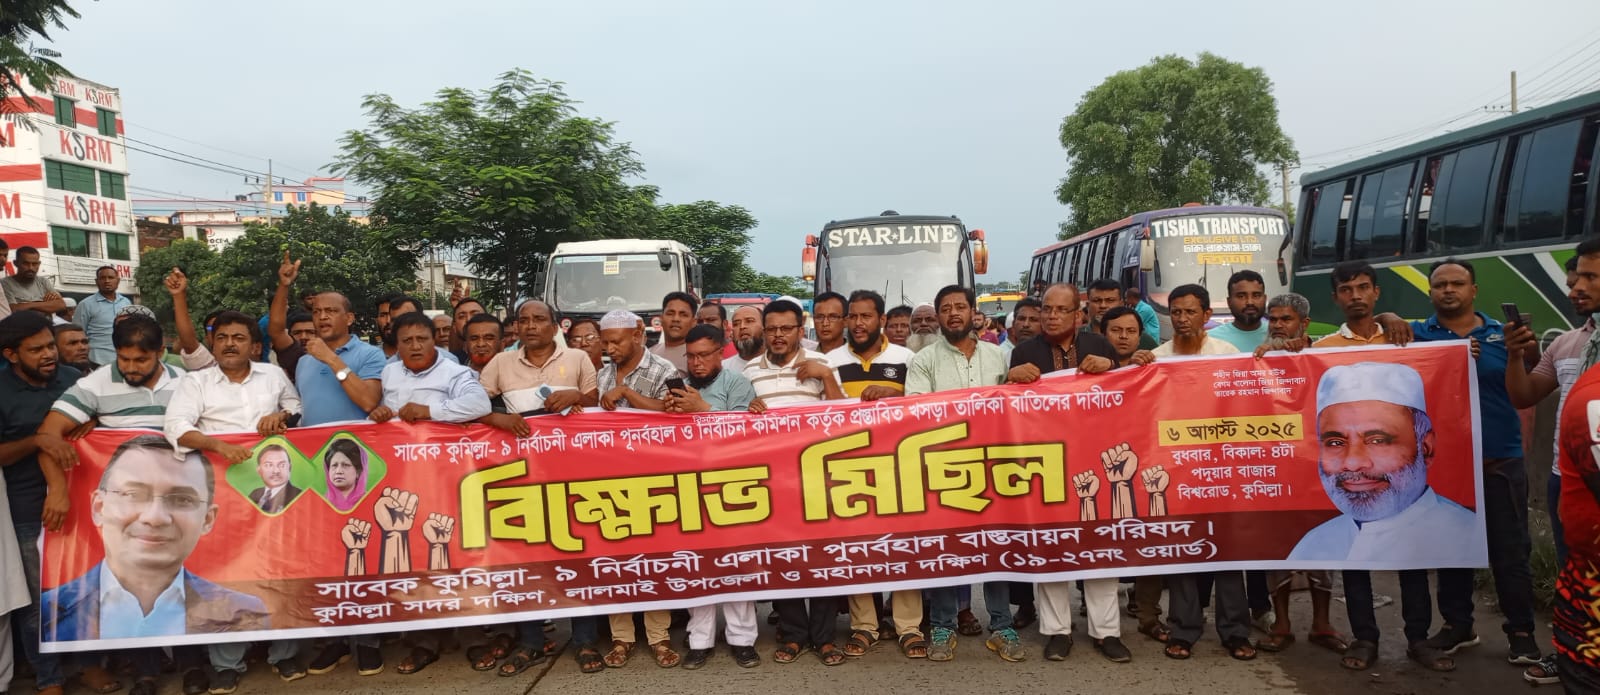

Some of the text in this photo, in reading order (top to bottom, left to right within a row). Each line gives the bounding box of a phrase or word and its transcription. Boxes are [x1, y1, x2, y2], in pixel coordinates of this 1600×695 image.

[85, 87, 113, 107] KSRM
[59, 129, 113, 164] KSRM
[63, 194, 117, 226] KSRM
[828, 224, 959, 248] STAR LINE
[1152, 217, 1285, 238] TISHA TRANSPORT
[1183, 235, 1238, 244] EXCLUSIVE
[1258, 377, 1274, 386] জিয়া
[1276, 376, 1306, 385] জিন্দাবাদ
[393, 442, 441, 462] সাবেক
[501, 440, 511, 456] ৯
[571, 430, 615, 450] এলাকা
[681, 425, 693, 440] ও
[805, 406, 845, 436] কর্তৃক
[850, 402, 904, 426] প্রস্তাবিত
[908, 401, 948, 422] খসড়া
[952, 392, 1004, 417] তালিকা
[1009, 389, 1072, 413] বাতিলের
[1074, 384, 1125, 410] দাবীতে
[1166, 419, 1297, 442] ৬ আগস্ট ২০২৫
[1221, 443, 1267, 461] বিকাল:
[1271, 442, 1295, 460] ৪টা
[1191, 464, 1276, 483] পদুয়ার বাজার
[459, 421, 1067, 553] বিক্ষোভ মিছিল
[1240, 480, 1283, 501] কুমিল্লা
[315, 577, 421, 600] সাবেক
[555, 565, 578, 582] ৯
[589, 550, 704, 580] নির্বাচনী
[714, 544, 813, 569] এলাকা
[823, 533, 947, 564] পুনর্বহাল
[956, 526, 1084, 549] বাস্তবায়ন
[1094, 518, 1196, 542] পরিষদ
[311, 601, 395, 625] কুমিল্লা
[401, 597, 464, 614] সদর
[565, 579, 658, 600] লালমাই
[666, 570, 772, 593] উপজেলা
[780, 570, 800, 582] ও
[809, 560, 909, 582] মহানগর
[916, 552, 989, 573] দক্ষিণ
[1136, 538, 1218, 560] ওয়ার্ড)
